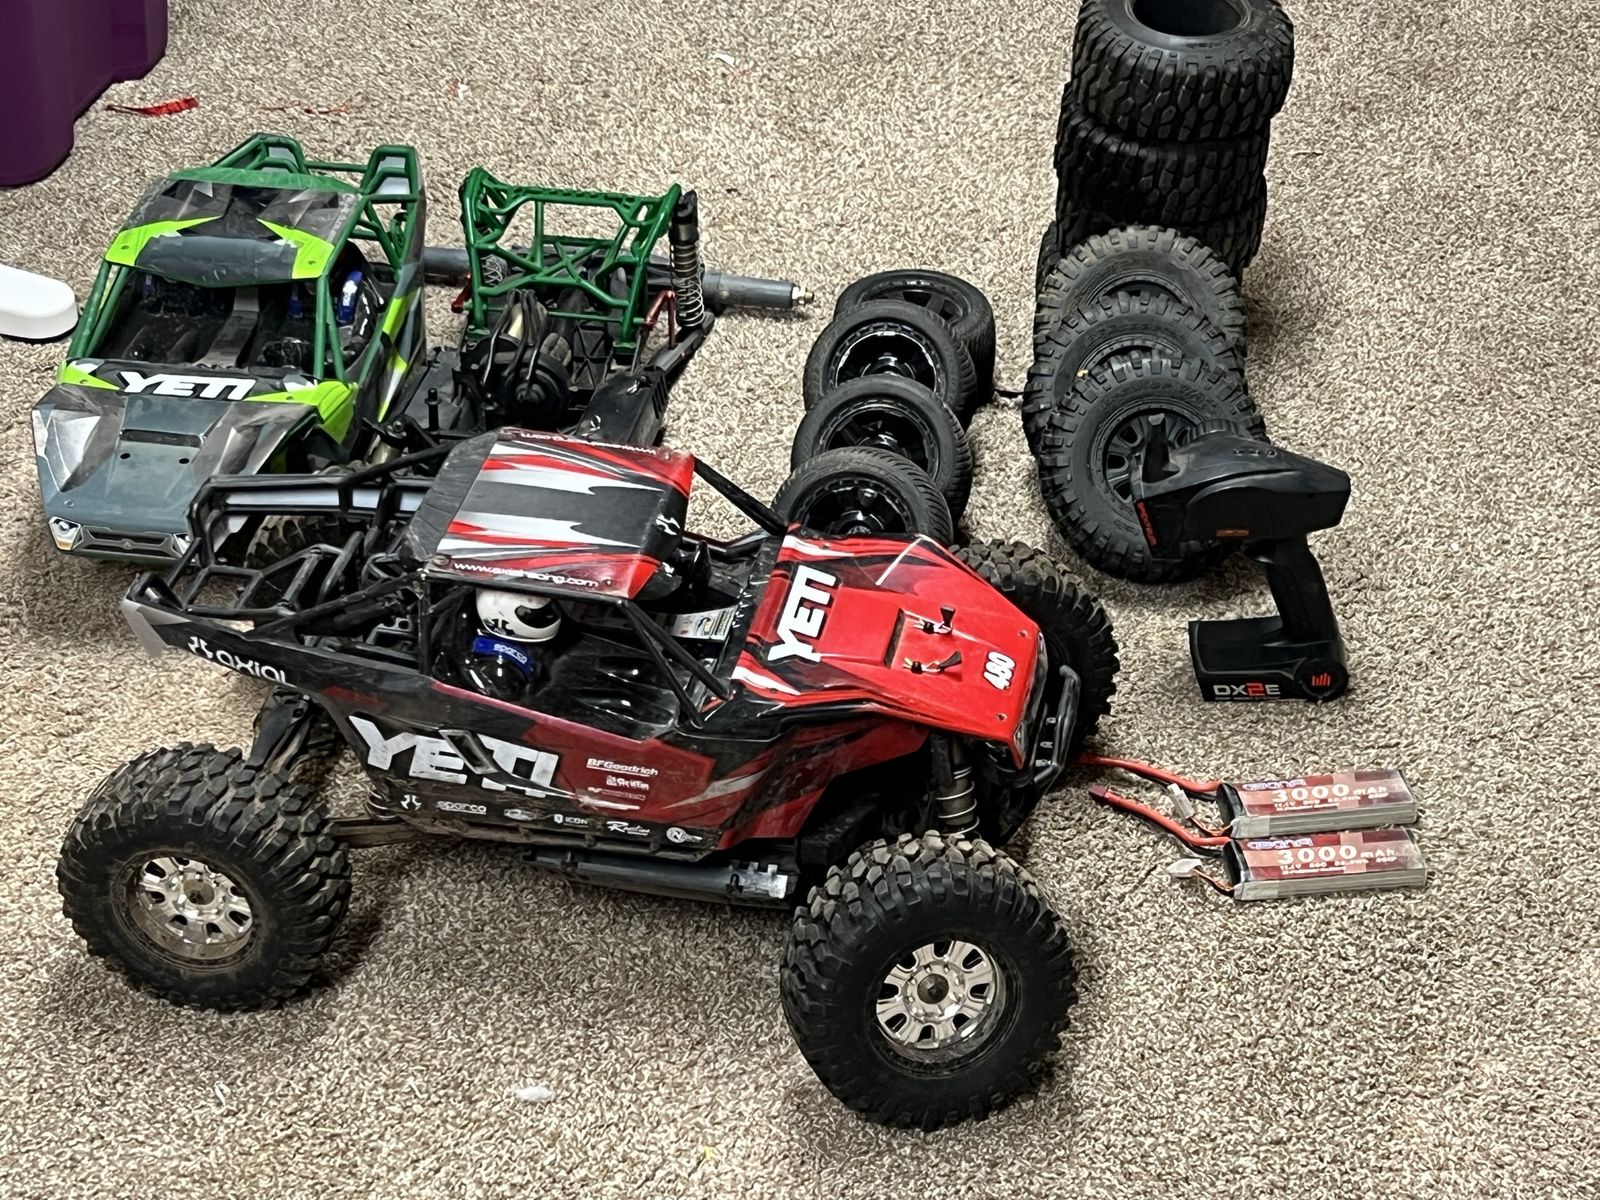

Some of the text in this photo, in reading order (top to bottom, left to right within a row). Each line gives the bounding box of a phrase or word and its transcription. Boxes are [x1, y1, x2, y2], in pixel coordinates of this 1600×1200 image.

[119, 371, 257, 401] YETI
[768, 564, 837, 663] YETI
[216, 650, 286, 685] axial
[983, 651, 1016, 690] 480
[1213, 682, 1281, 698] DX2E
[348, 715, 560, 799] YETI
[586, 758, 658, 777] BFGoodrich
[436, 801, 487, 815] sparco
